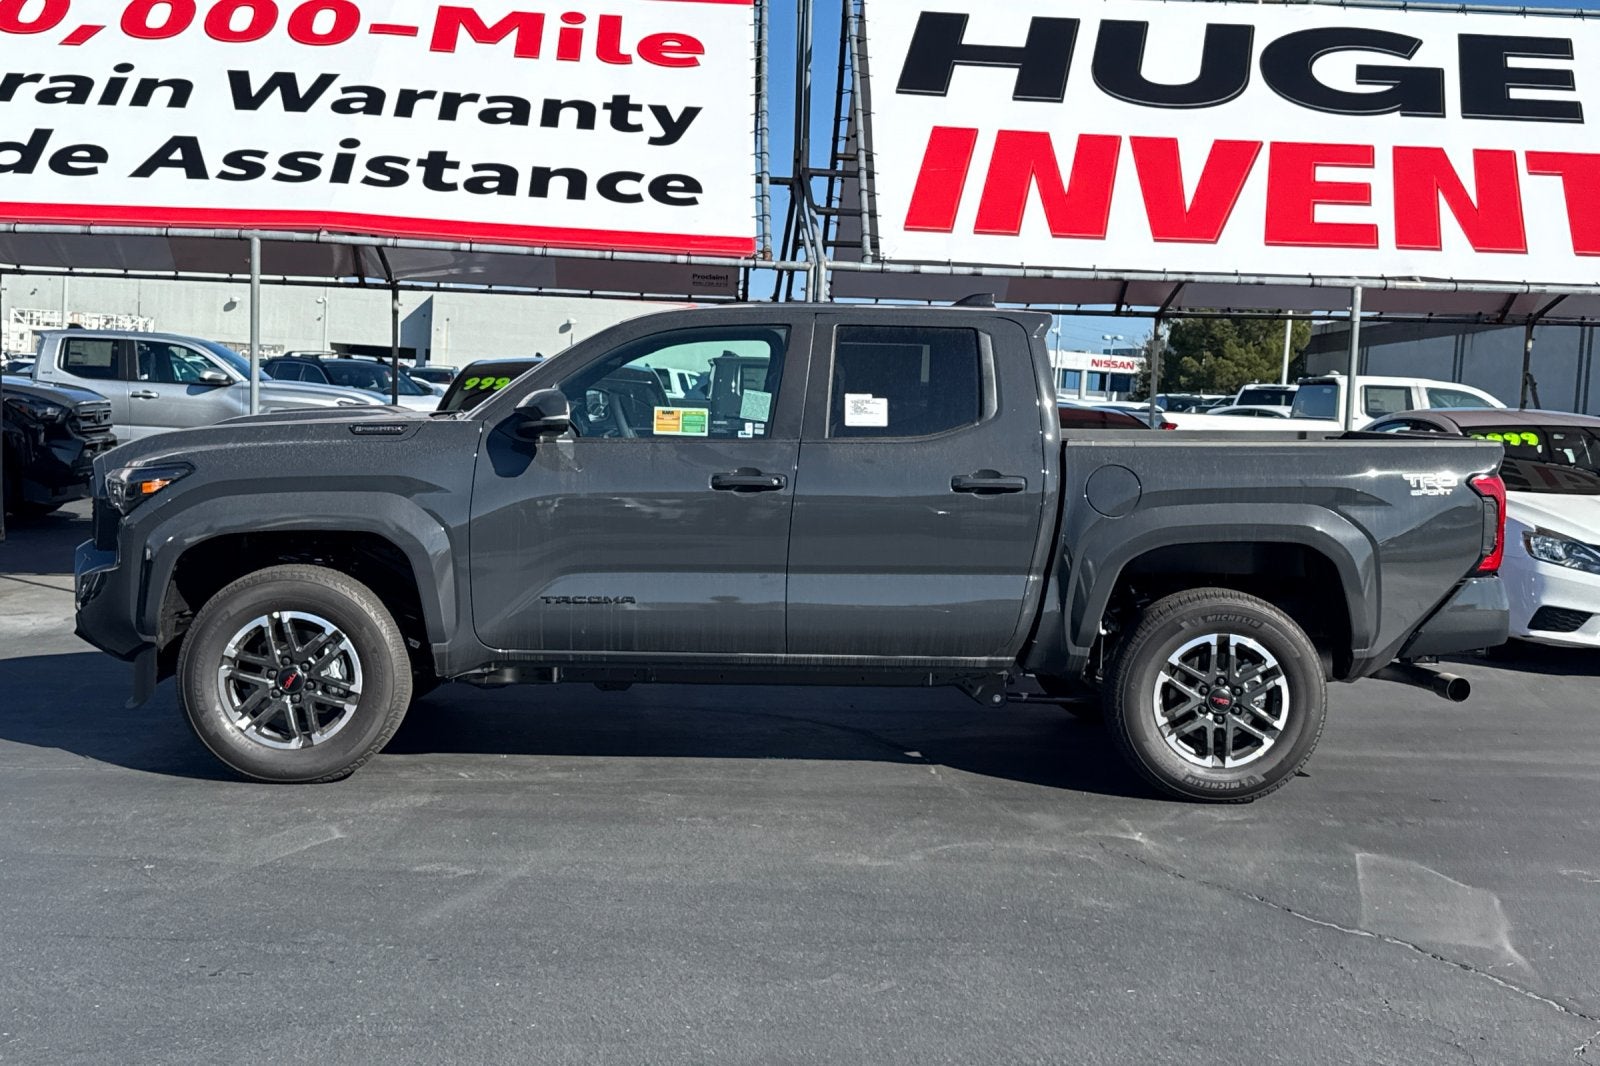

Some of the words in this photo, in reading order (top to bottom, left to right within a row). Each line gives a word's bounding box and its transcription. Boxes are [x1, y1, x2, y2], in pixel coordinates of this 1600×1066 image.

[896, 11, 1585, 124] HUGE
[0, 62, 194, 109] rain
[227, 69, 704, 146] Warranty
[127, 135, 704, 207] Assistance
[903, 126, 1600, 256] INVENT
[1091, 358, 1135, 370] NISSAN
[1402, 472, 1458, 489] TRD
[1410, 488, 1453, 496] SPORT
[540, 596, 636, 604] TACOMA
[1206, 614, 1262, 629] MICHELIN
[1183, 775, 1240, 790] MICHELIN
